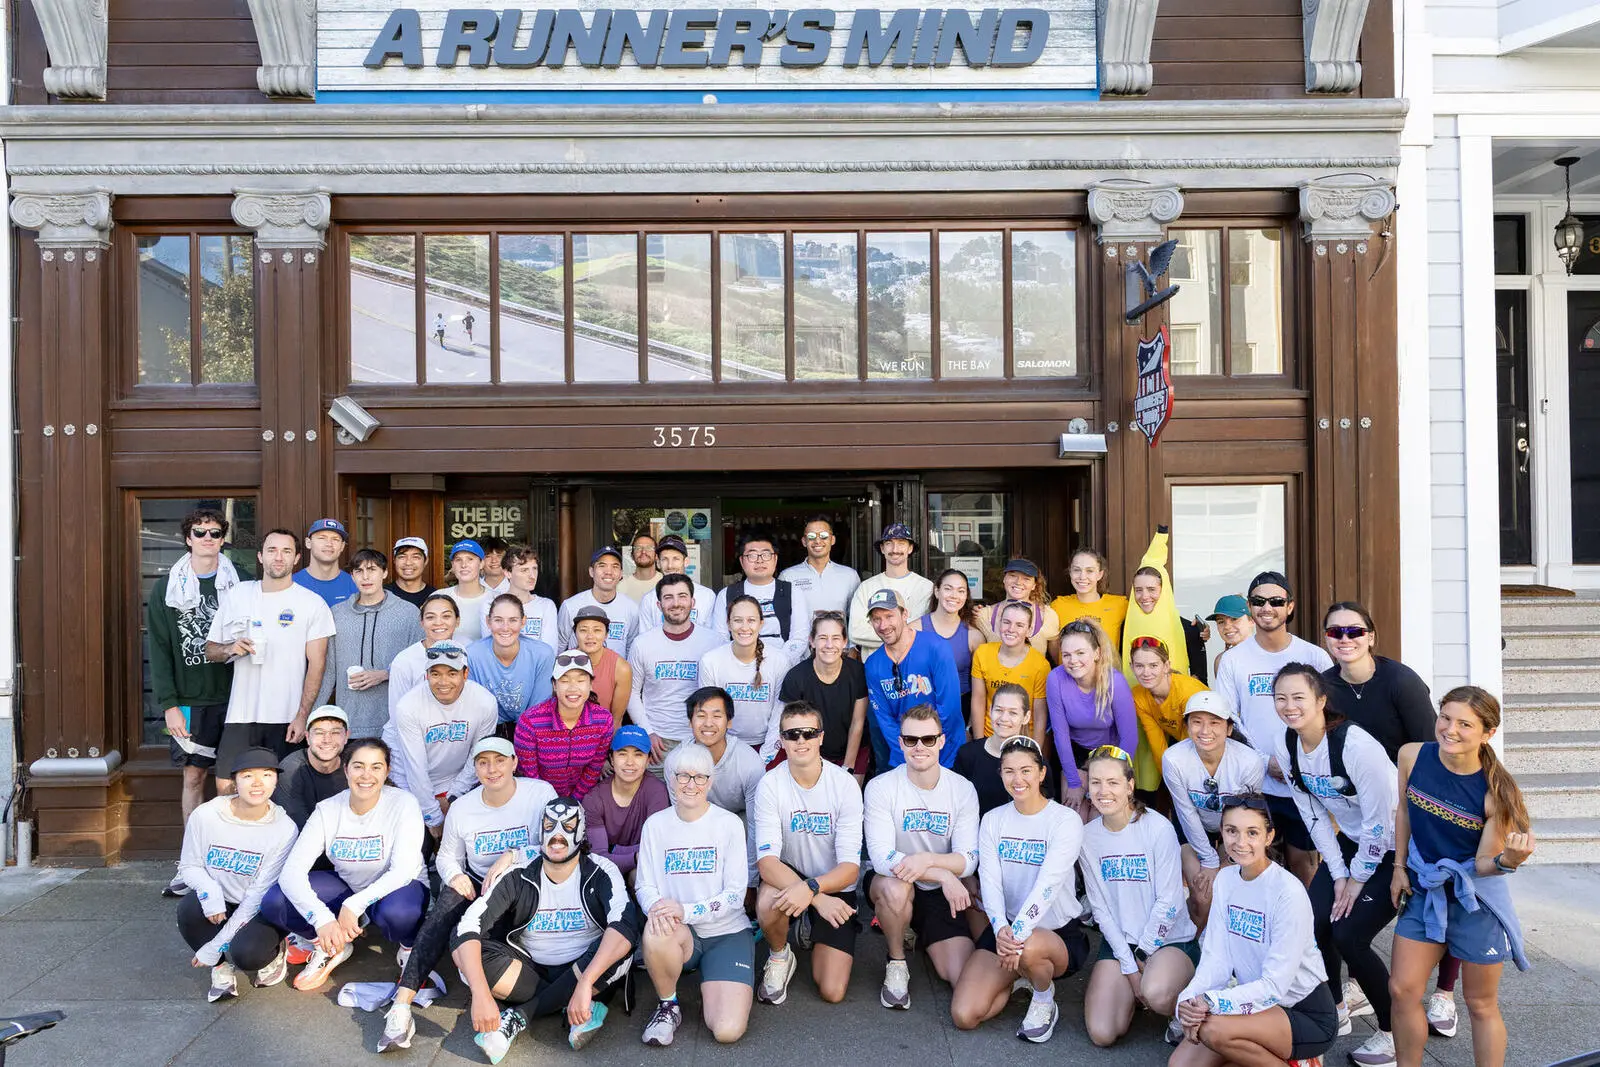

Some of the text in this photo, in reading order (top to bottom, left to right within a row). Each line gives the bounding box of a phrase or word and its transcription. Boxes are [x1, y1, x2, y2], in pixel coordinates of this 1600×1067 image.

[363, 8, 1051, 69] A RUNNER'S MIND
[880, 360, 991, 372] WE RUN THE BAY
[1017, 360, 1072, 368] SALOMON
[653, 426, 716, 447] 3575
[451, 506, 521, 522] THE BIG
[451, 522, 515, 539] SOFTIE
